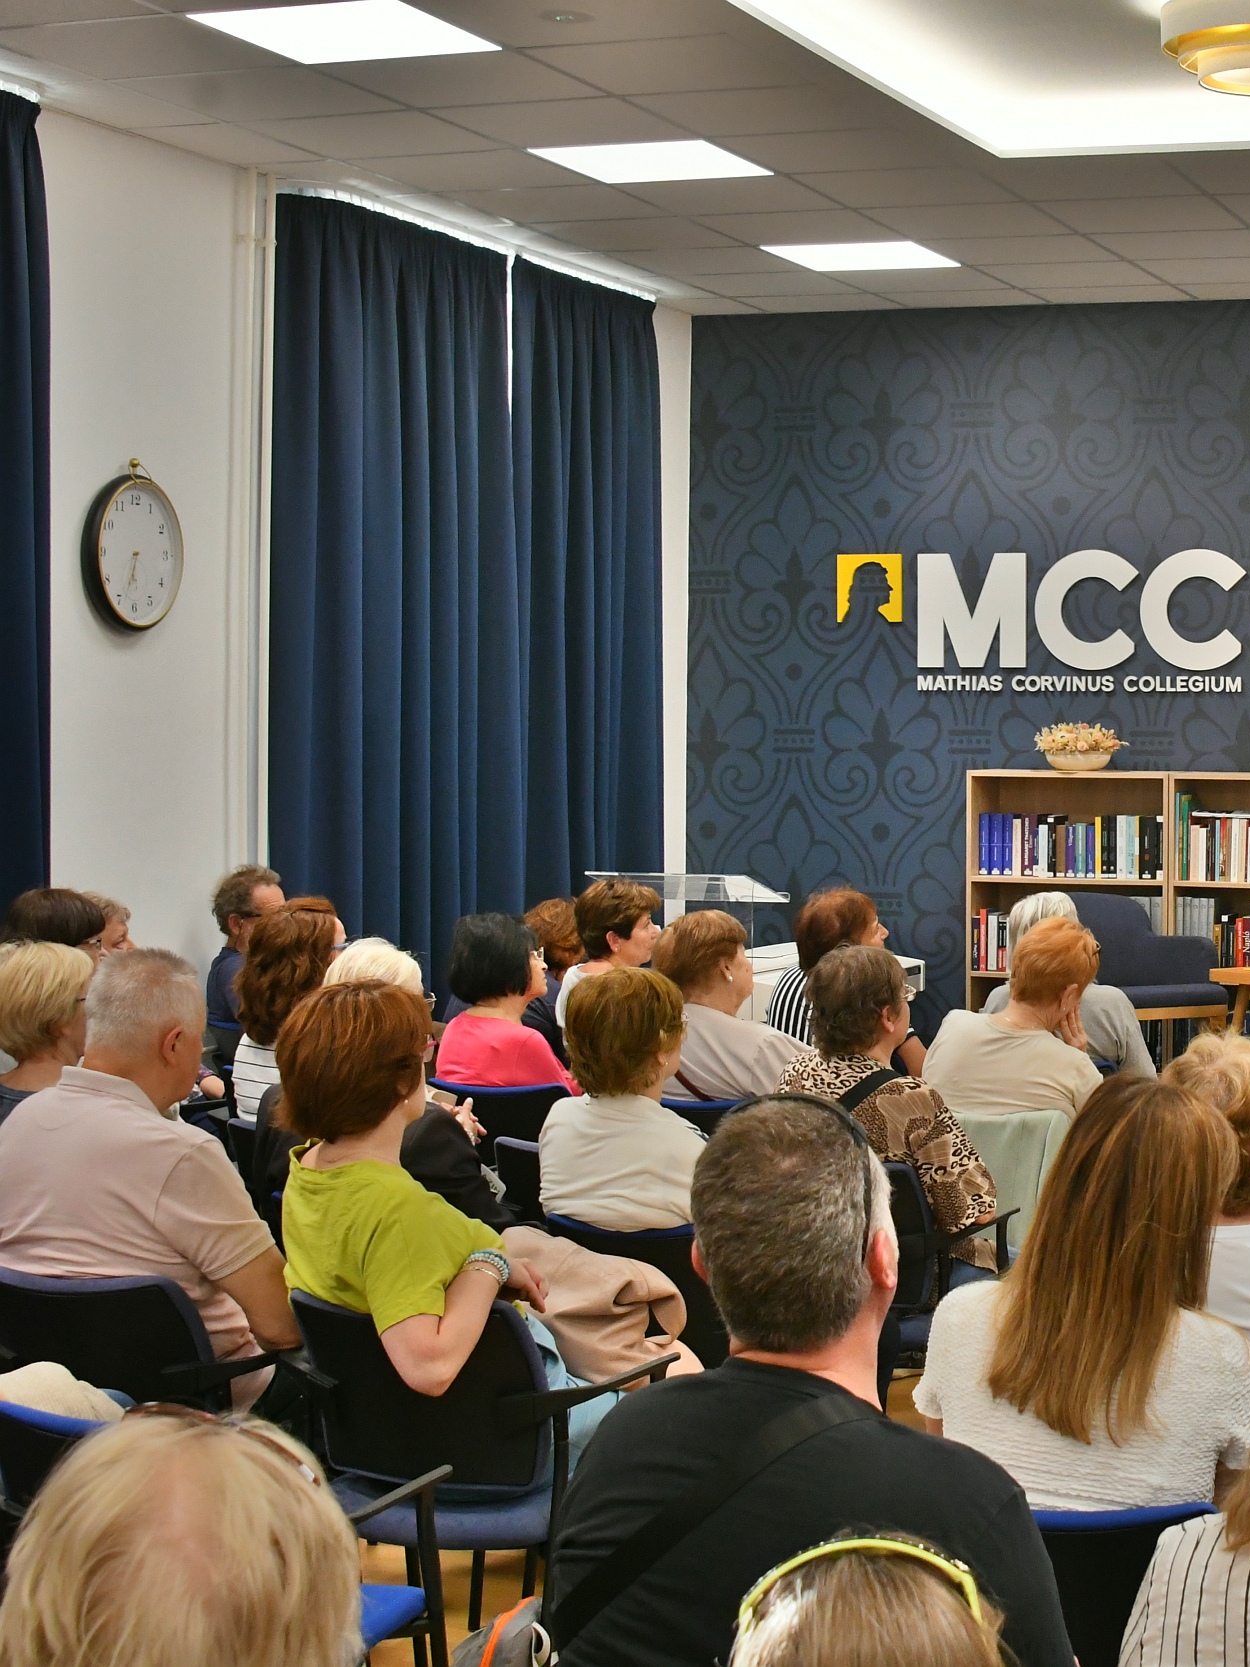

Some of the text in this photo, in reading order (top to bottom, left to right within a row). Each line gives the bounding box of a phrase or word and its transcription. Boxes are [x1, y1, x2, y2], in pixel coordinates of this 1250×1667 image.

[130, 494, 141, 506] 12
[114, 501, 125, 512] 11
[158, 524, 164, 535] 2
[100, 546, 106, 557] 9
[163, 550, 169, 562] 3
[104, 574, 111, 585] 8
[158, 577, 164, 588] 4
[116, 594, 122, 606] 7
[147, 595, 153, 607] 5
[131, 602, 138, 613] 6
[917, 548, 1247, 671] MCC
[917, 675, 1242, 693] MATHIAS CORVINUS COLLEGIUM
